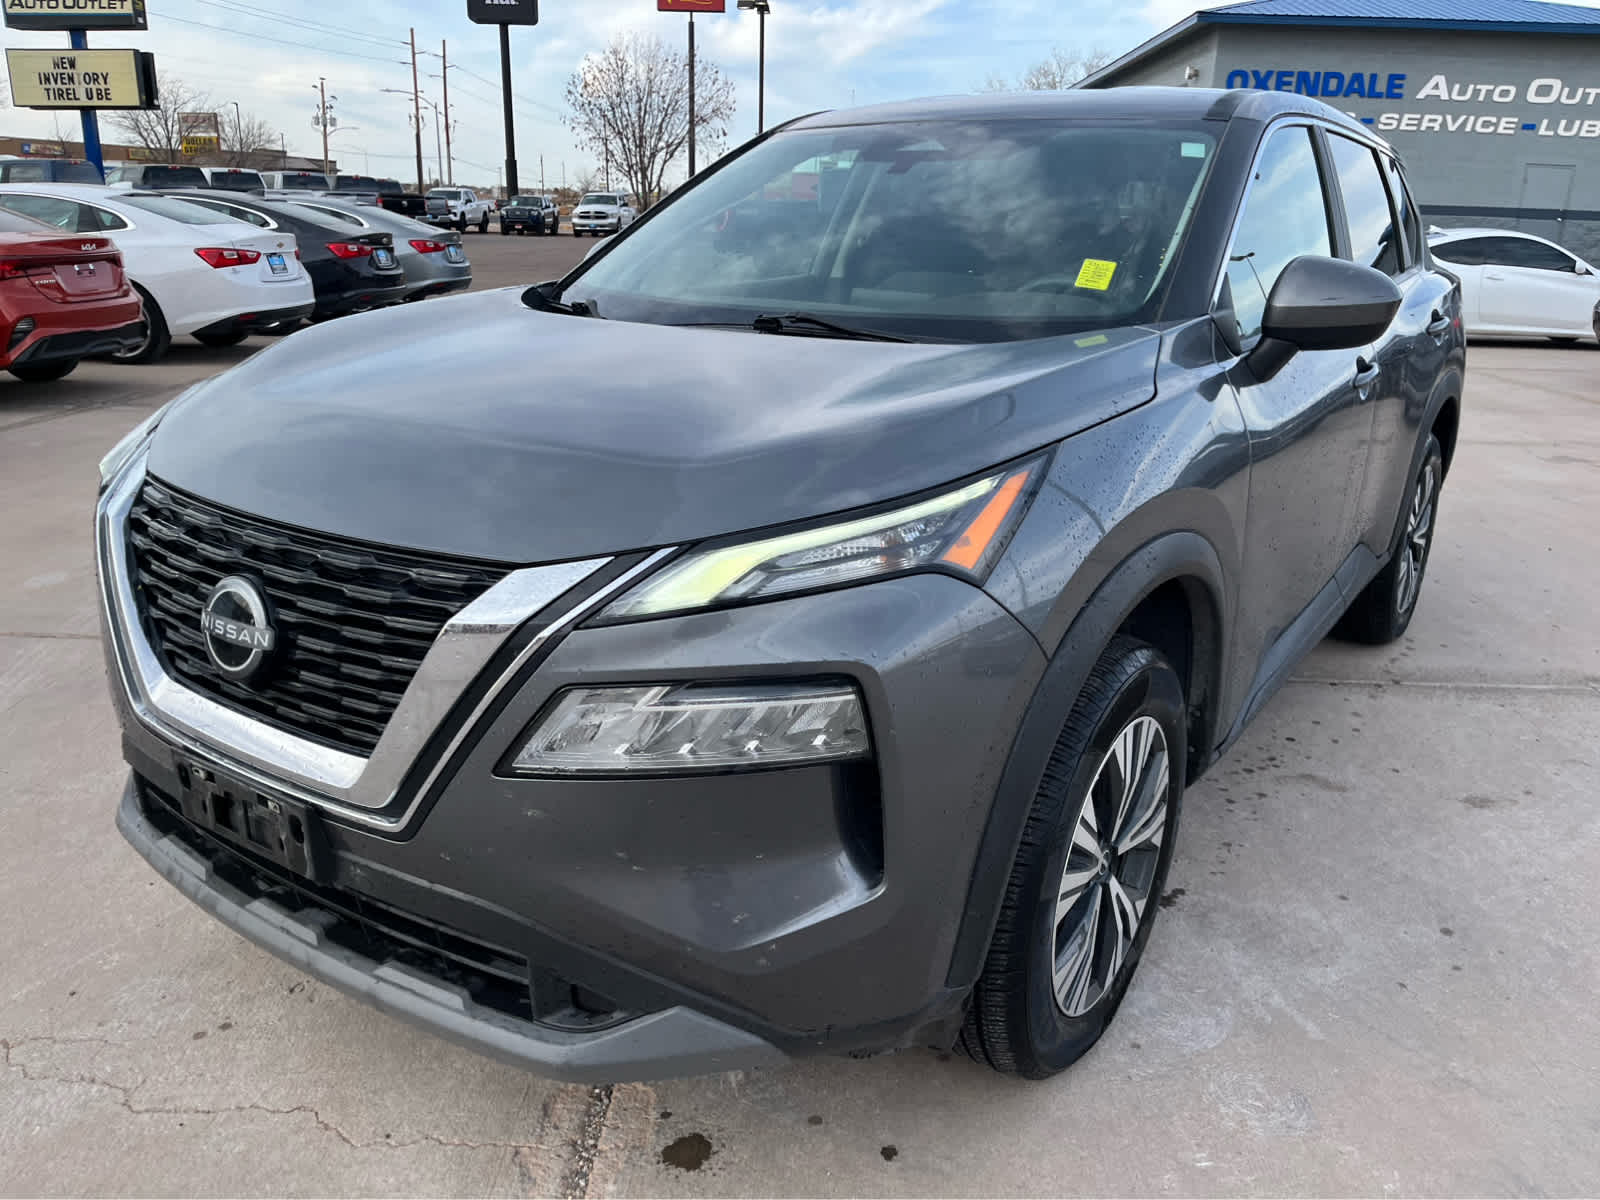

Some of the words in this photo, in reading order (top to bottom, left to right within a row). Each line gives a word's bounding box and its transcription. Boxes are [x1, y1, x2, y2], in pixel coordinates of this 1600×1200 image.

[8, 0, 59, 9] AUTO
[62, 0, 127, 9] OUTLET
[53, 56, 76, 70] NEW
[38, 72, 108, 85] INVENORY
[1226, 70, 1406, 99] OXENDALE
[1415, 74, 1517, 104] AUTO
[201, 610, 269, 647] NISSAN
